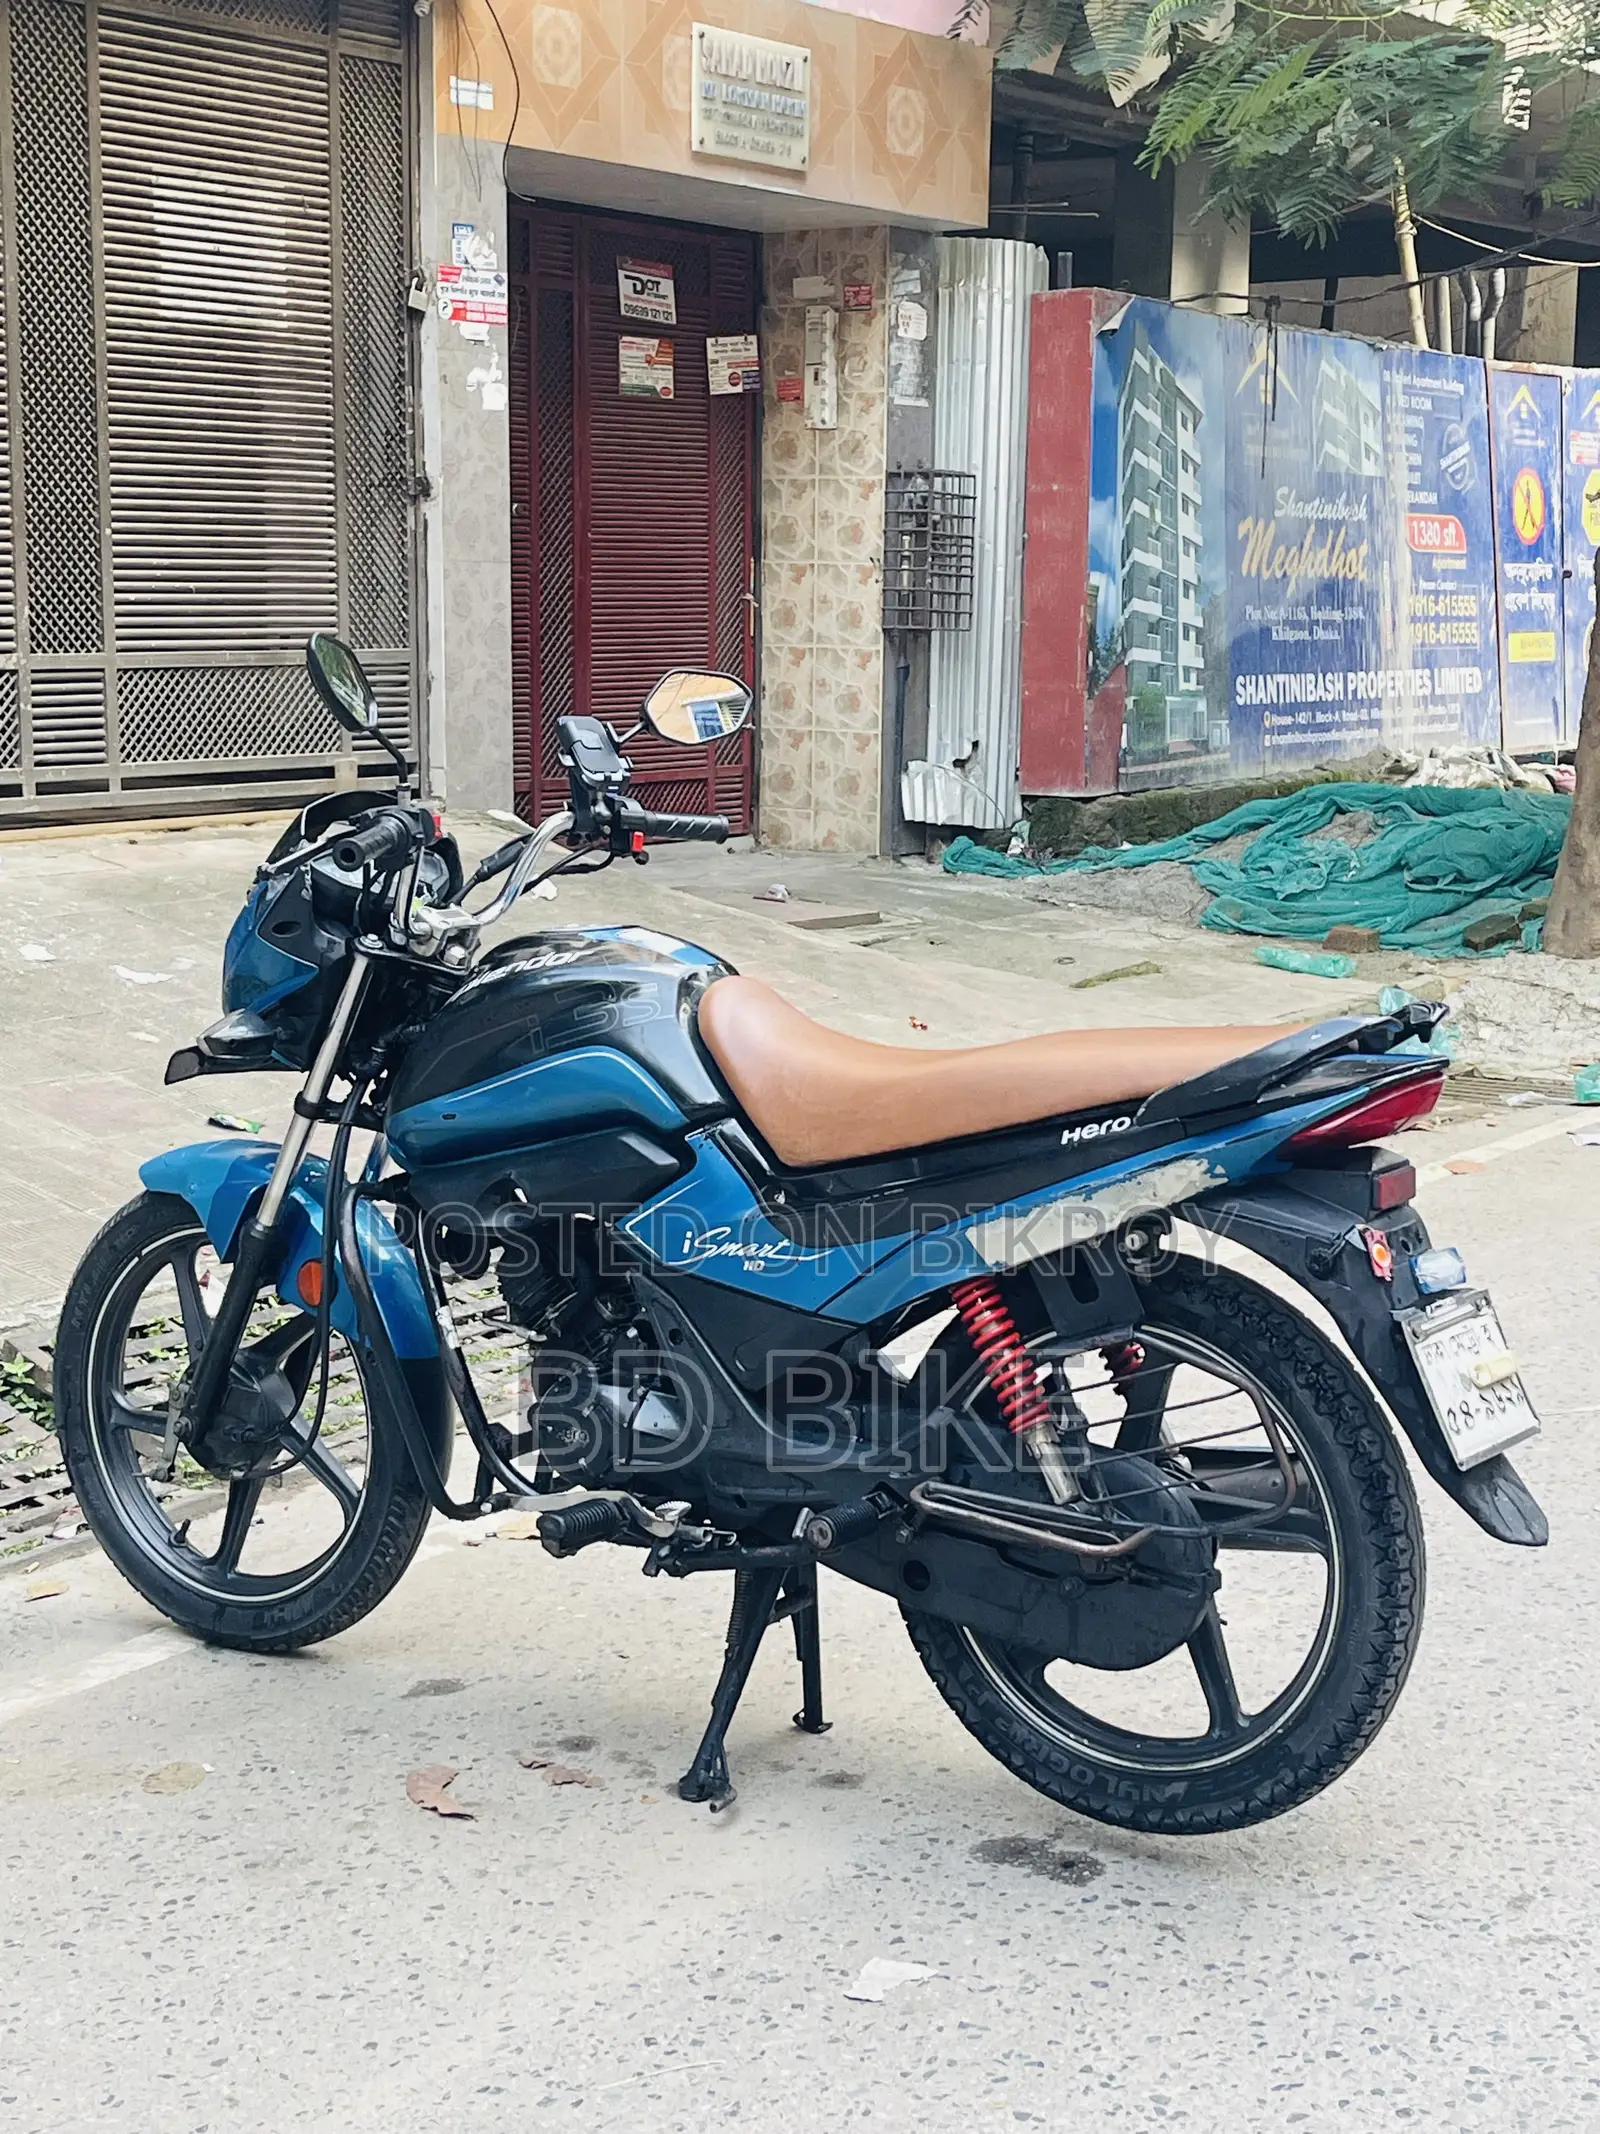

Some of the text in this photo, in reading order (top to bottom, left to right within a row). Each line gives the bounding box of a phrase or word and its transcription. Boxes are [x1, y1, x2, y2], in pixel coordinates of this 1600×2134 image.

[1235, 666, 1483, 706] SHANTINIBASH PROPERTIES LIMITED
[1060, 1115, 1132, 1146] Hero
